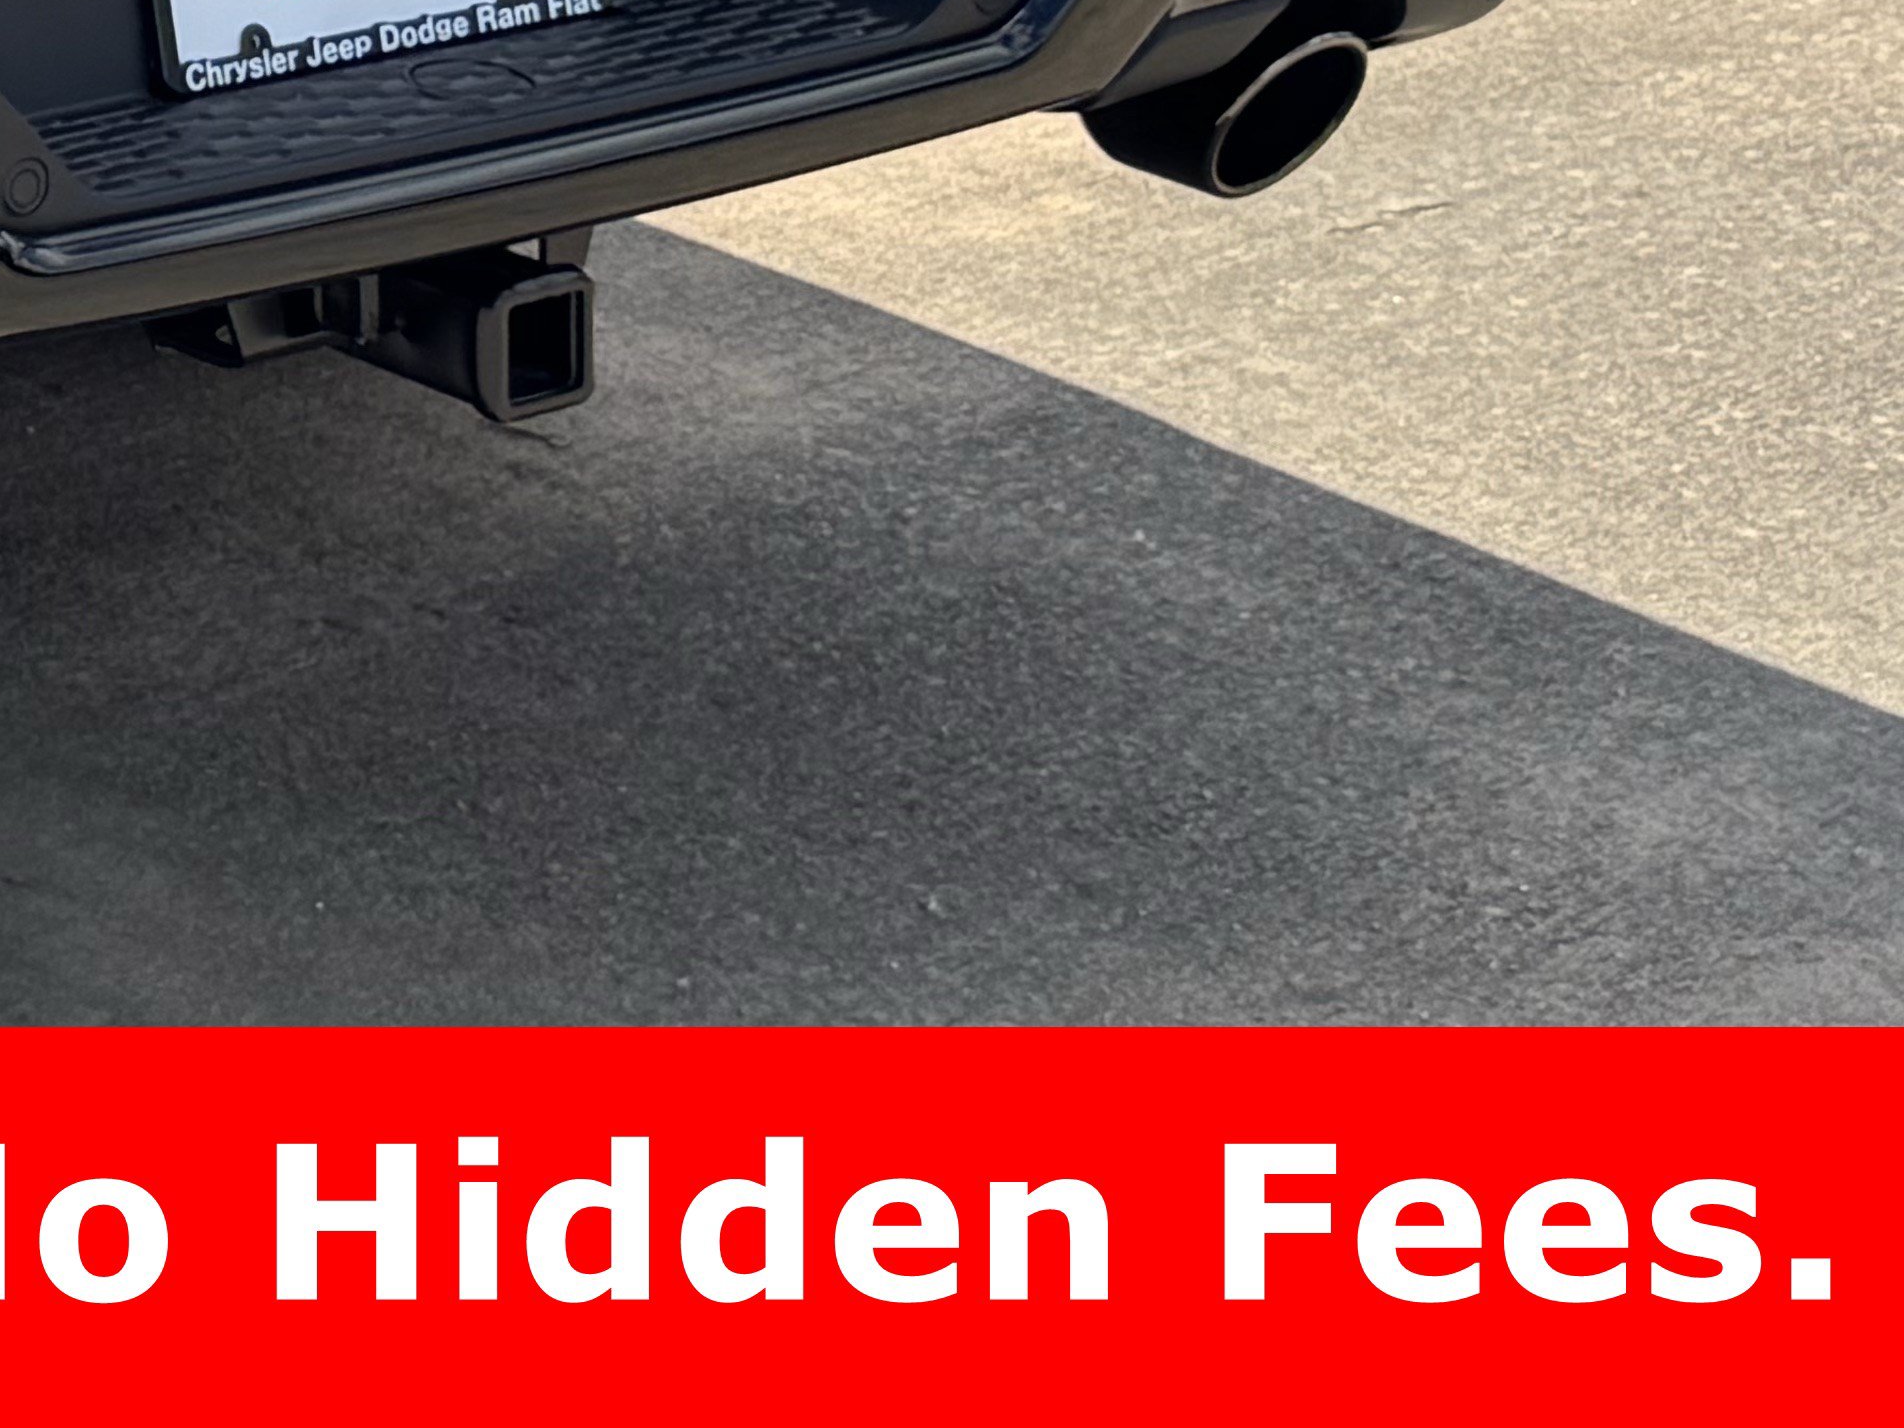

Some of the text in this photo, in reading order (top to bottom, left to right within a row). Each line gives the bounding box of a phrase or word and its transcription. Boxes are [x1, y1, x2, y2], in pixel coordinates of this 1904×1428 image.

[185, 48, 299, 93] Chrysler
[306, 34, 372, 68] Jeep
[379, 15, 469, 52] Dodge
[477, 0, 540, 32] Ram
